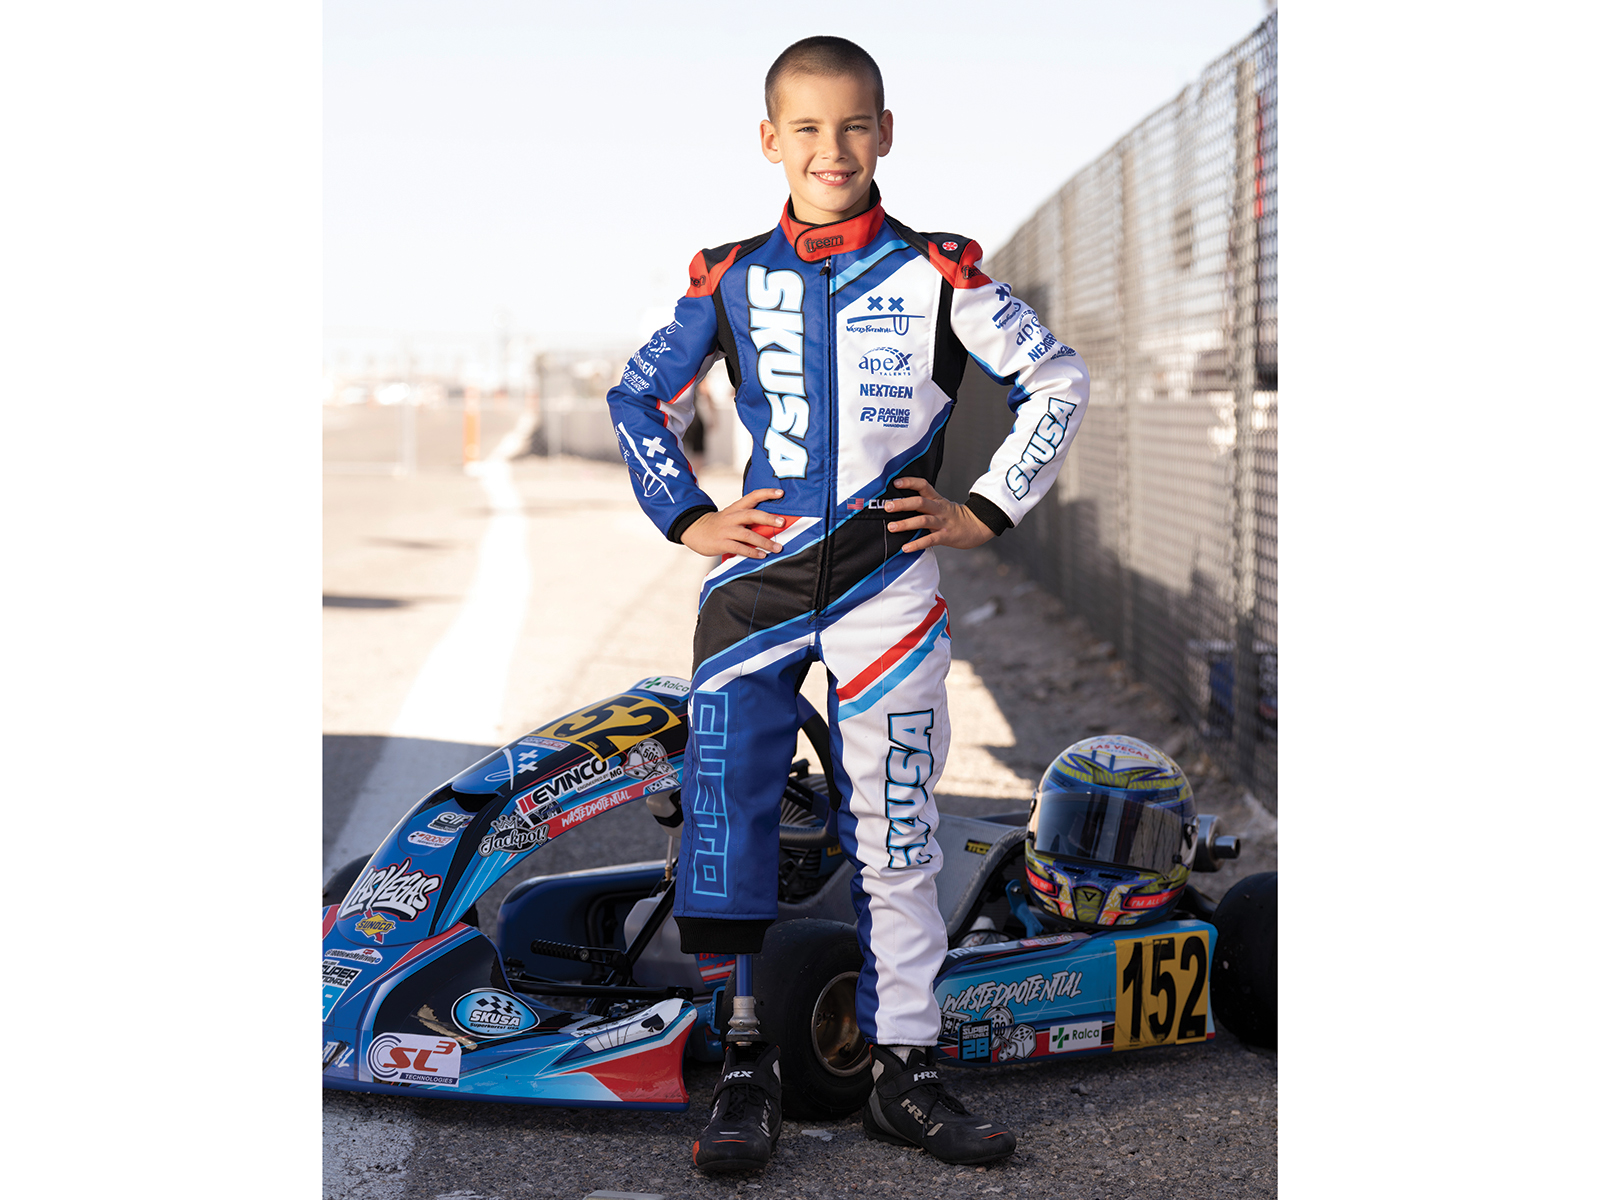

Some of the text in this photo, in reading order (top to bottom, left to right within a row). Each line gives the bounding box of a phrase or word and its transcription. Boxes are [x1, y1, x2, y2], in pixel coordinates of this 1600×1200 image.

[804, 235, 843, 252] freem
[746, 264, 809, 480] SKUSA
[860, 383, 913, 399] NEXTGEN
[877, 415, 909, 423] FUTURE
[878, 408, 910, 416] RACING
[1006, 397, 1077, 501] SKUSA
[662, 680, 690, 692] Ralca
[1114, 745, 1150, 760] VEGAS
[610, 768, 622, 778] MG
[693, 690, 728, 897] CUETO
[885, 708, 934, 869] SKUSA
[562, 790, 632, 827] WASTEDPOTENTIAL
[480, 826, 548, 855] Jackpot!
[367, 858, 441, 919] VEGAS
[1146, 898, 1160, 906] ALL
[358, 919, 394, 931] SUNOCO
[942, 970, 1083, 1012] WASTEDPOTENTIAL
[1122, 936, 1207, 1043] 152
[469, 1010, 521, 1026] SKUSA
[963, 1025, 989, 1035] SUPER
[1072, 1029, 1099, 1040] Ralca
[962, 1037, 989, 1060] 28
[405, 1074, 453, 1083] TECHNOLOGIES
[723, 1070, 754, 1082] HRX
[913, 1070, 938, 1082] HRX
